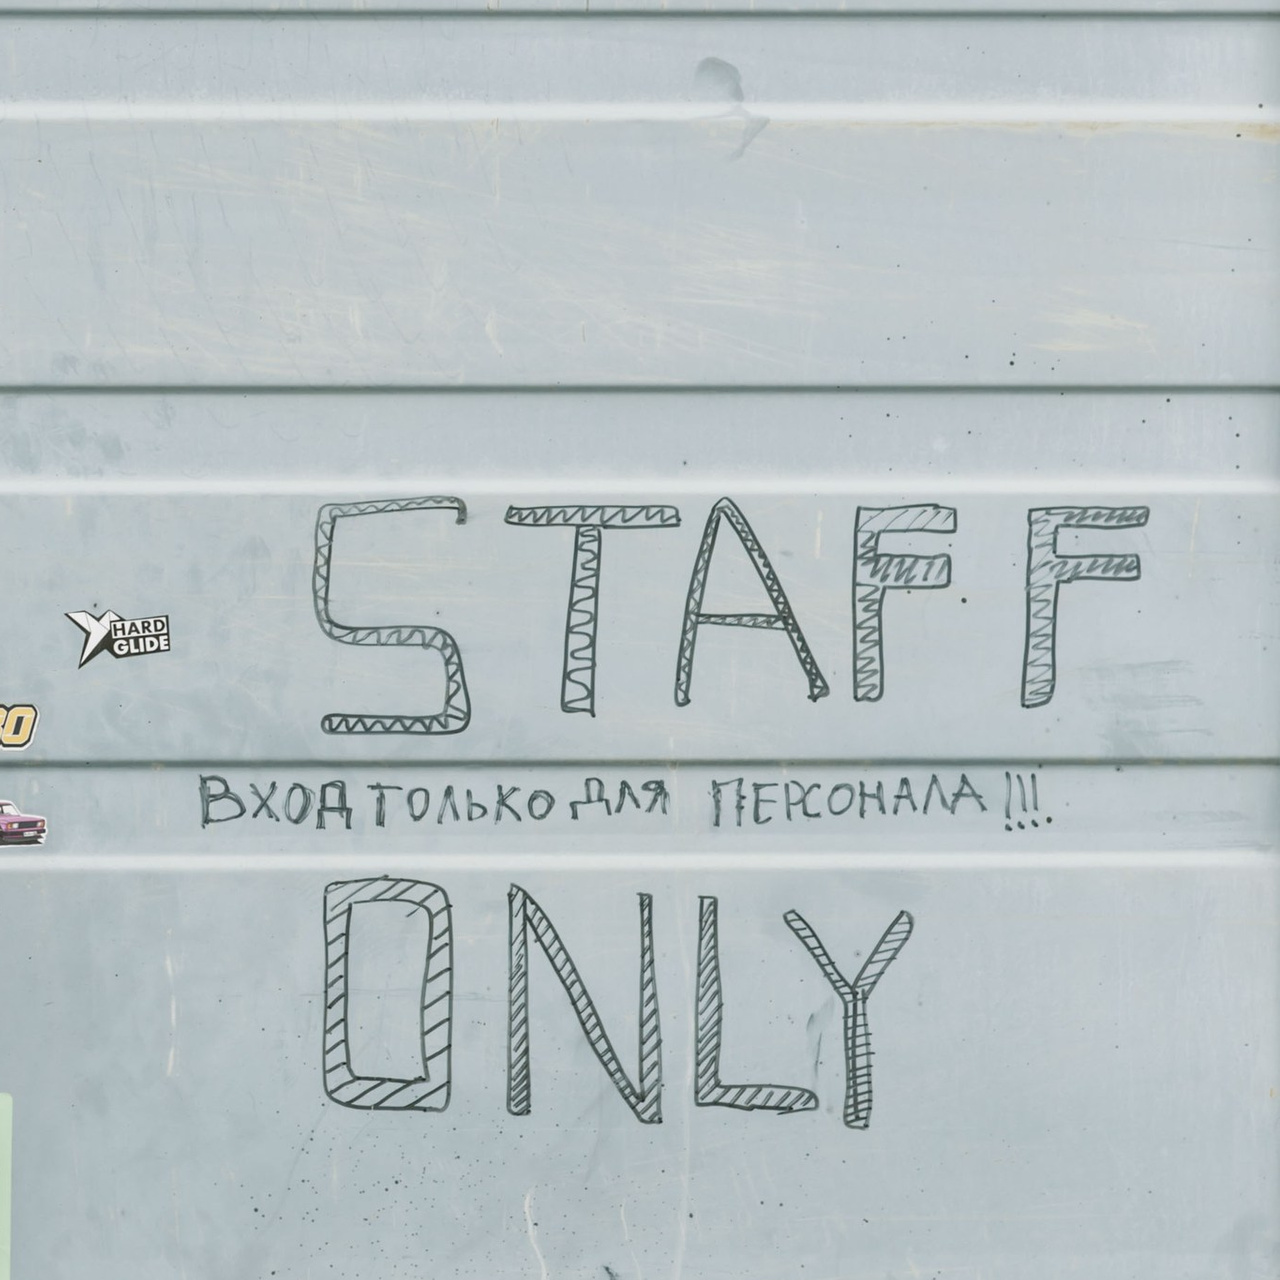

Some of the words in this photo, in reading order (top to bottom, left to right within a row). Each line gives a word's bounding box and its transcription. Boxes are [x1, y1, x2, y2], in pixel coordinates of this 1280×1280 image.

[112, 618, 166, 638] HARD
[312, 496, 1150, 734] STAFF
[113, 635, 170, 656] GLIDE
[198, 773, 351, 830] ВХОД
[366, 780, 555, 827] ТОЛЬКО
[570, 776, 670, 822] ДЛЯ
[322, 875, 915, 1130] ONLY
